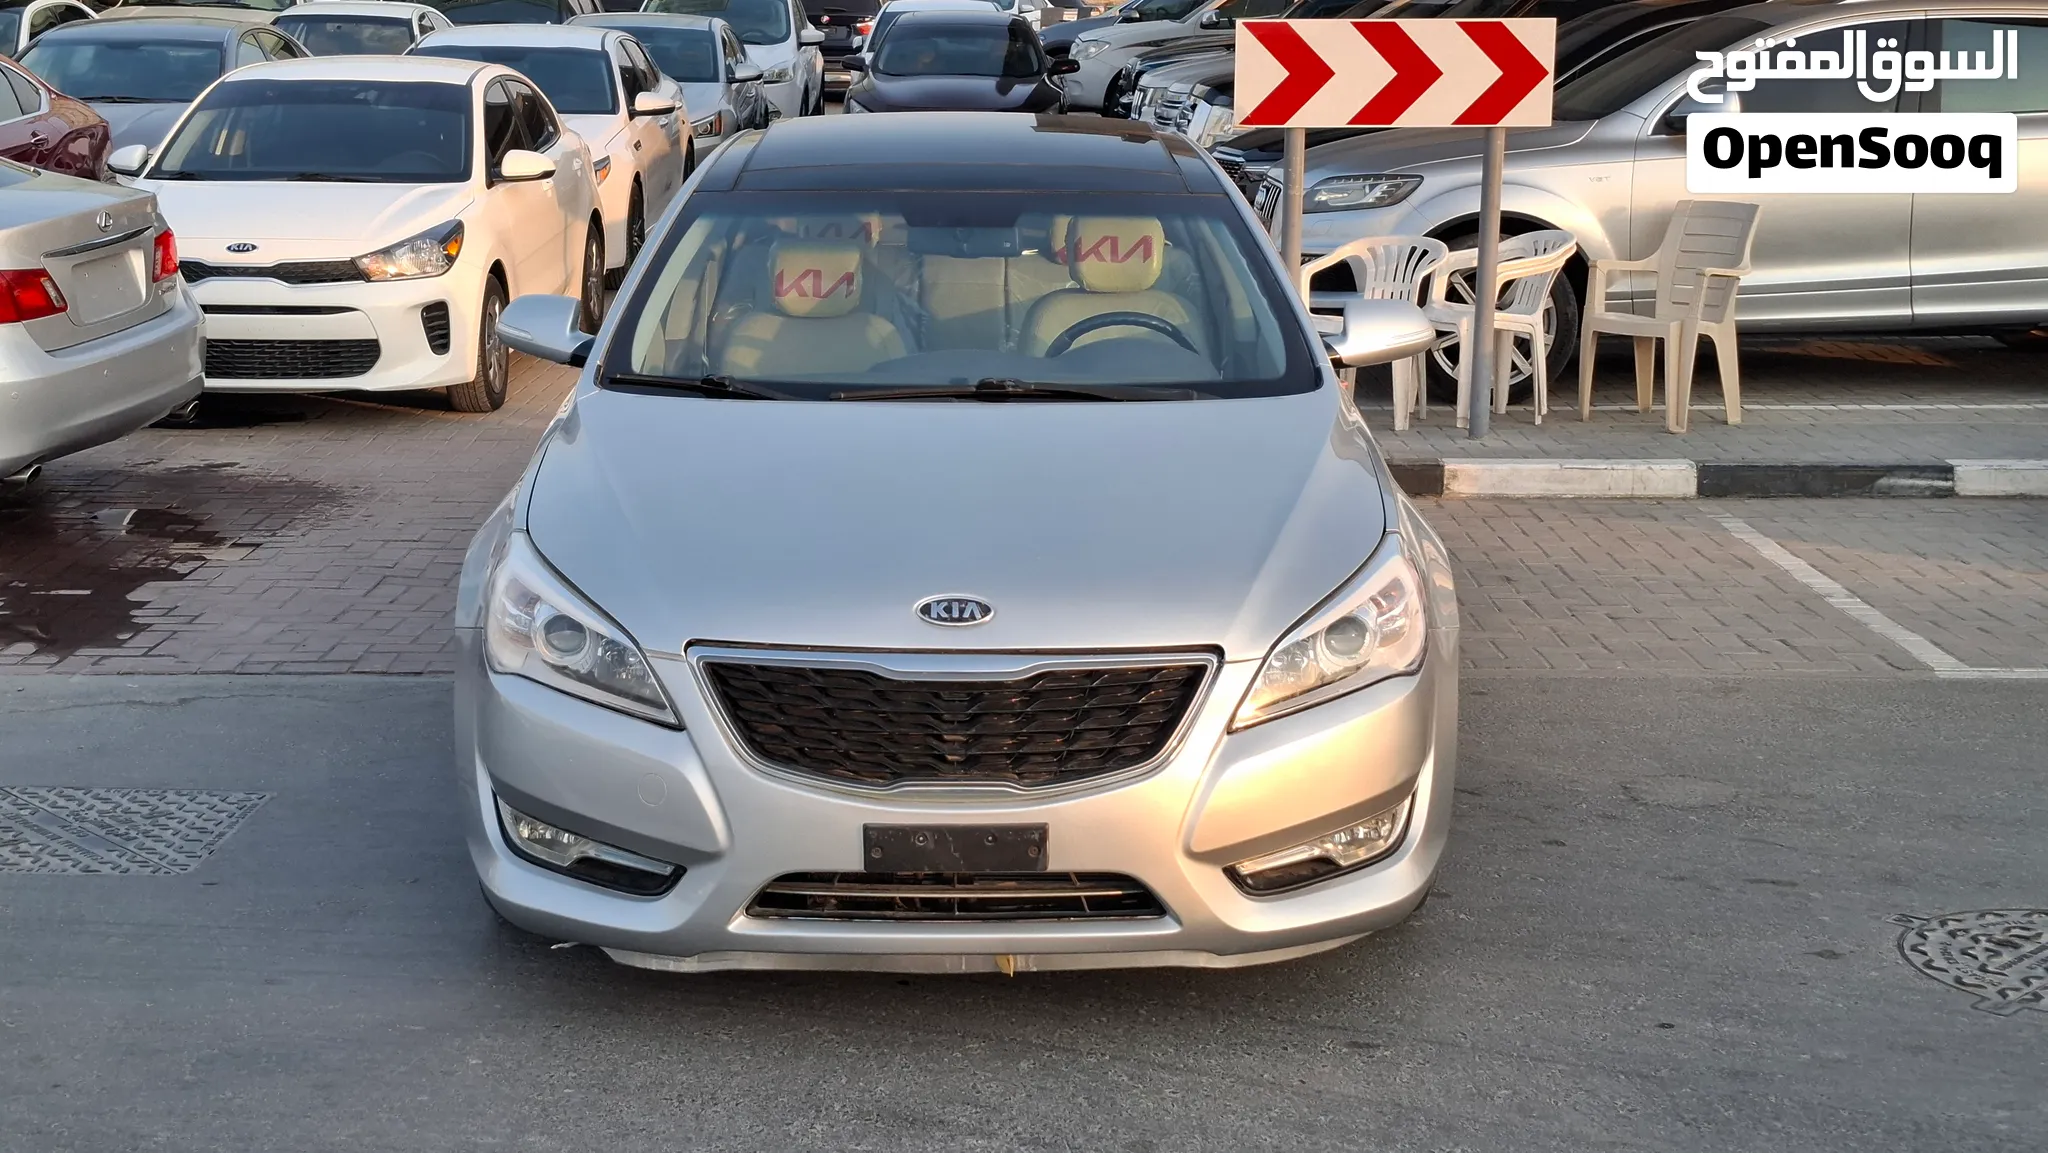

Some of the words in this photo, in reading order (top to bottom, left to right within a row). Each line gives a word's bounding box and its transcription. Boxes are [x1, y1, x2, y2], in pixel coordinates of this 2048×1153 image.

[230, 243, 252, 251] KIA
[1074, 235, 1152, 263] KIA
[775, 268, 854, 299] KIA
[930, 601, 982, 619] KIA
